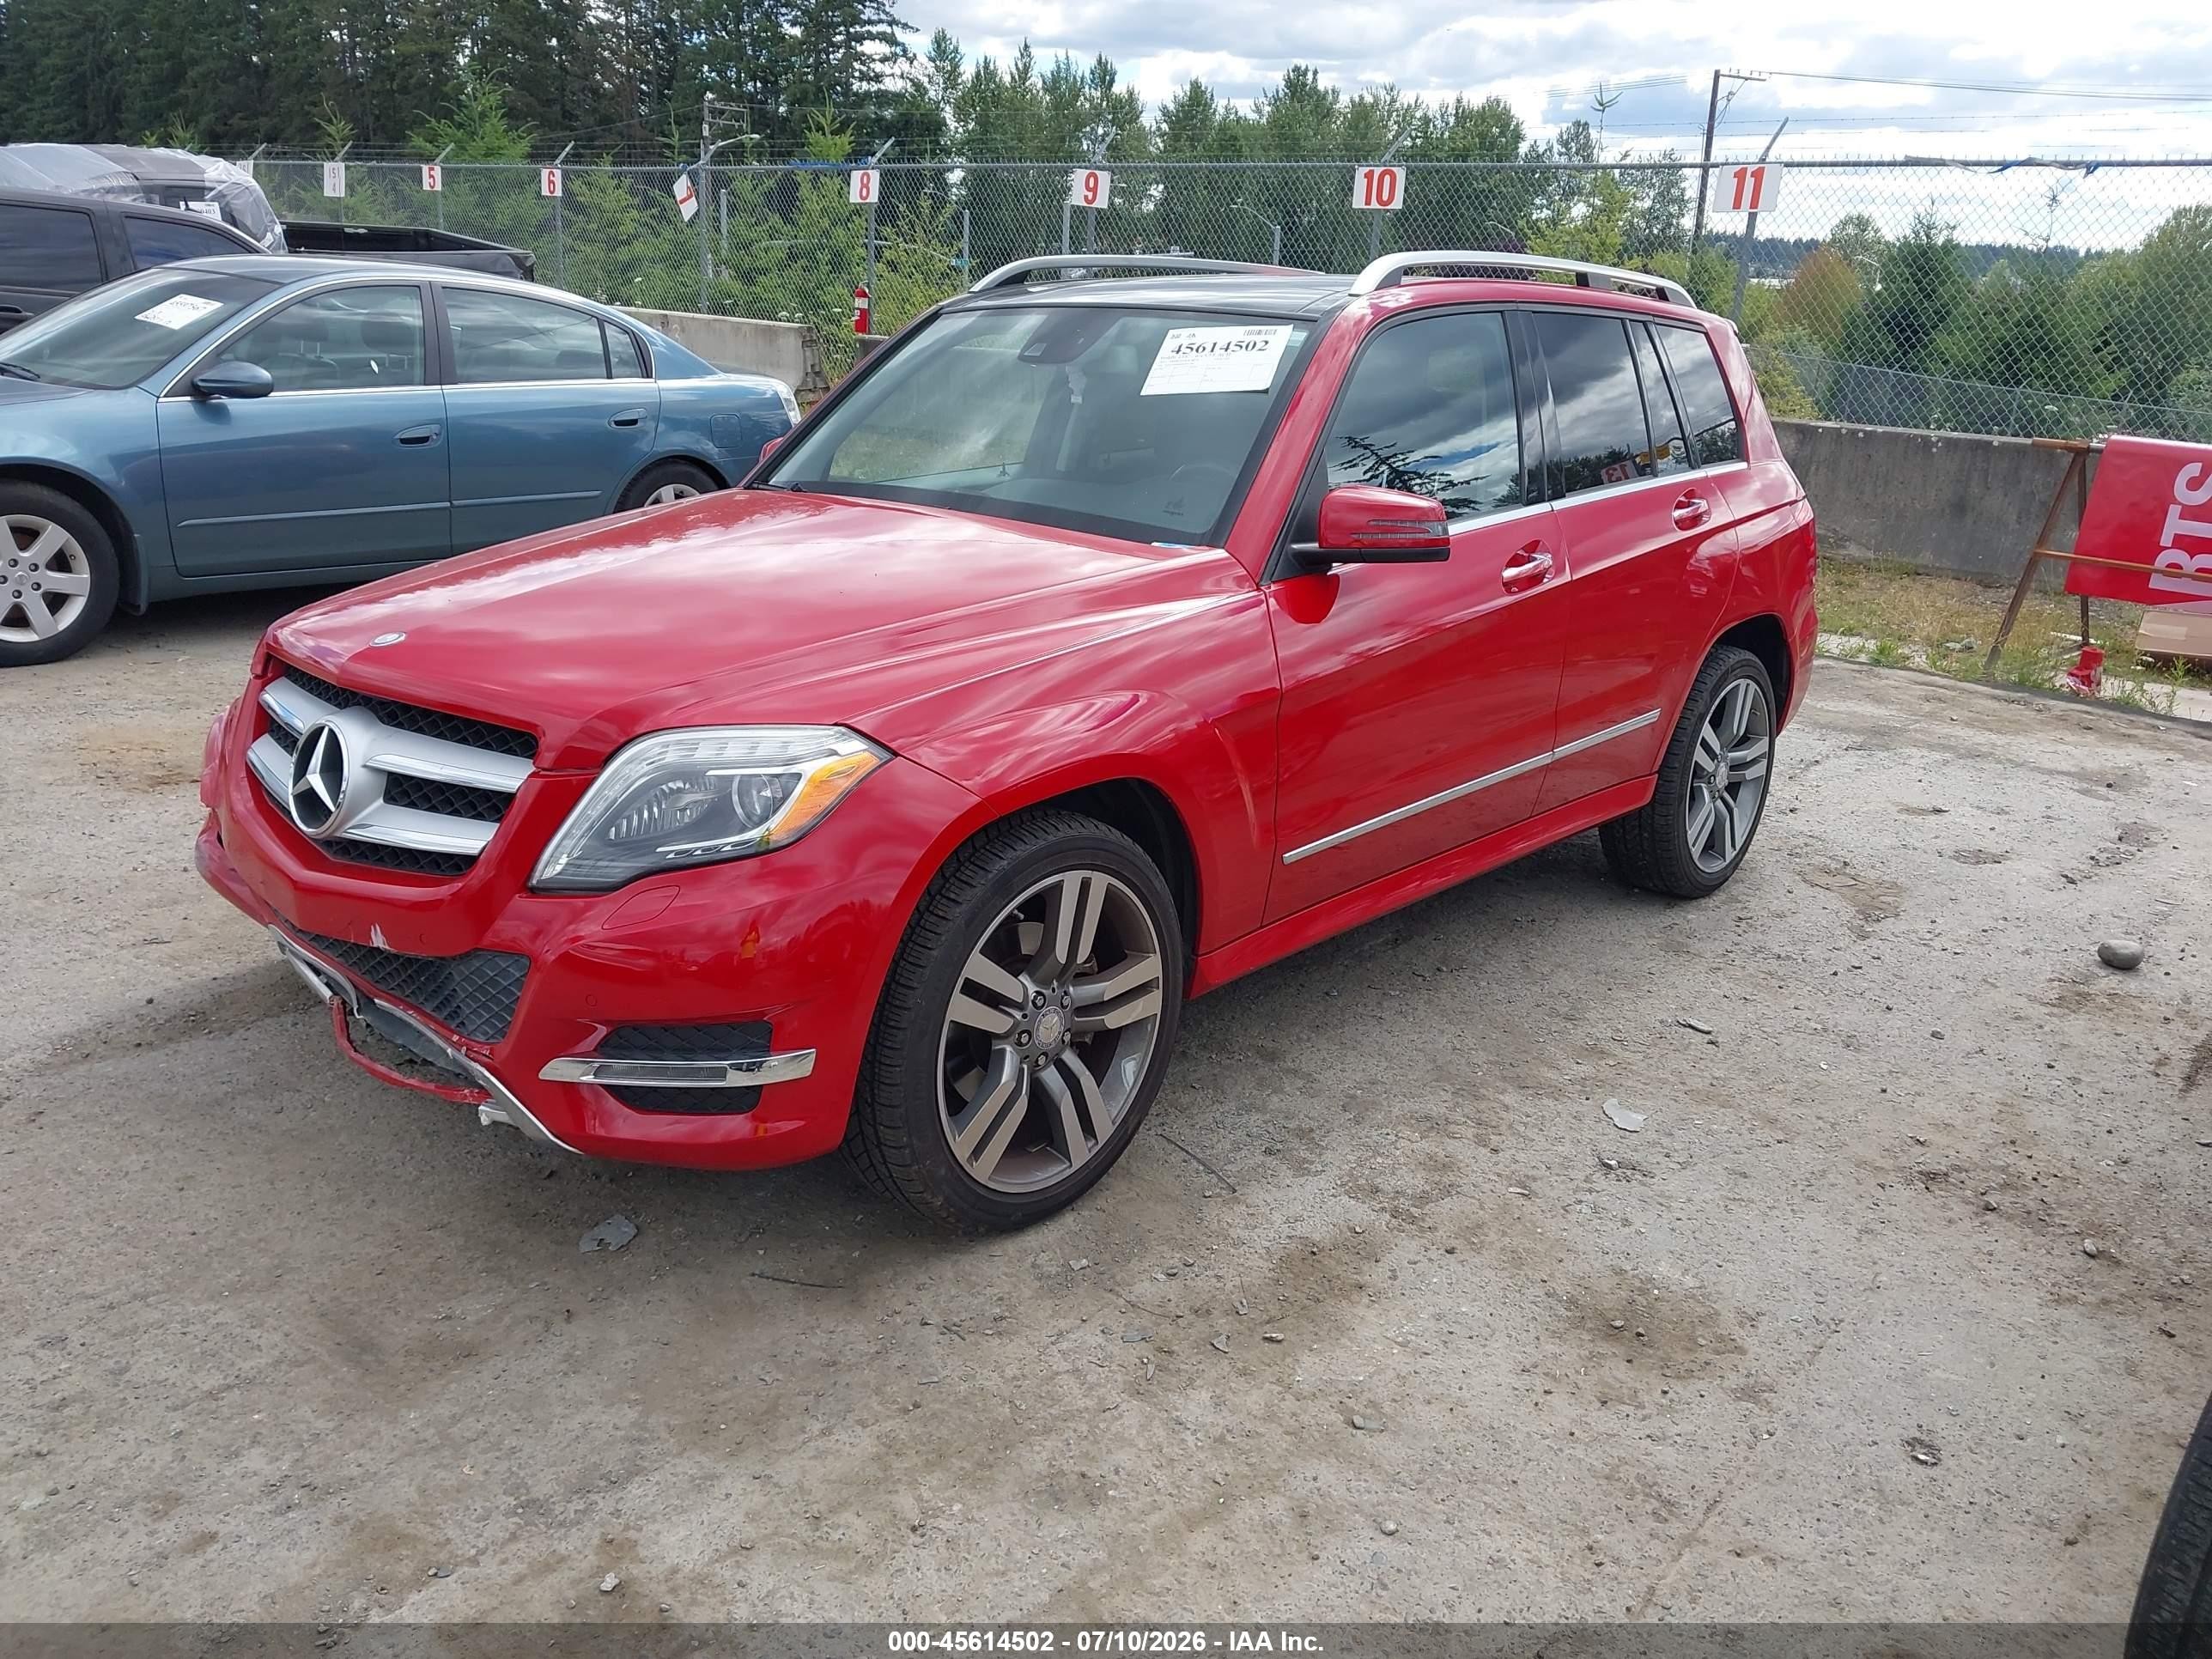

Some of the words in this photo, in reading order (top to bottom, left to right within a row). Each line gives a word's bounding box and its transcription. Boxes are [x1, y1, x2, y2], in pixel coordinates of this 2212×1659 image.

[428, 167, 436, 190] 5
[547, 170, 556, 195] 6
[859, 171, 872, 201] 8
[1084, 171, 1099, 205] 9
[1364, 168, 1397, 207] 10
[1731, 166, 1766, 210] 11
[1170, 339, 1269, 355] 45614502
